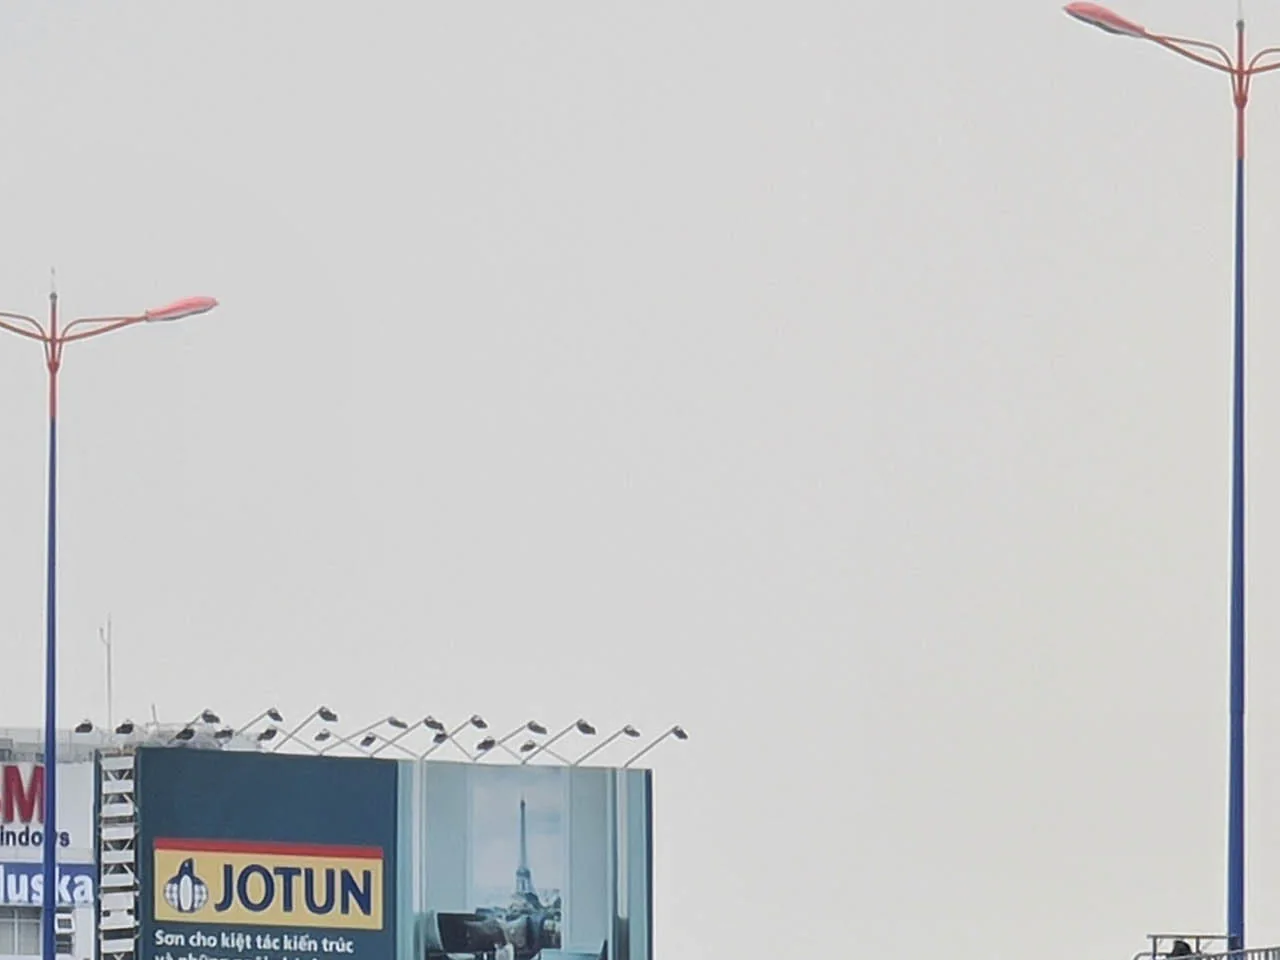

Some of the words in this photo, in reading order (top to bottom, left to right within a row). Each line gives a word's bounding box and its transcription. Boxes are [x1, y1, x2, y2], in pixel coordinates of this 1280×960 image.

[215, 863, 372, 916] JOTUN
[155, 930, 185, 947] Sơn
[189, 931, 217, 948] cho
[221, 932, 252, 952] kiệt
[256, 934, 280, 950] tác
[283, 934, 318, 952] kiến
